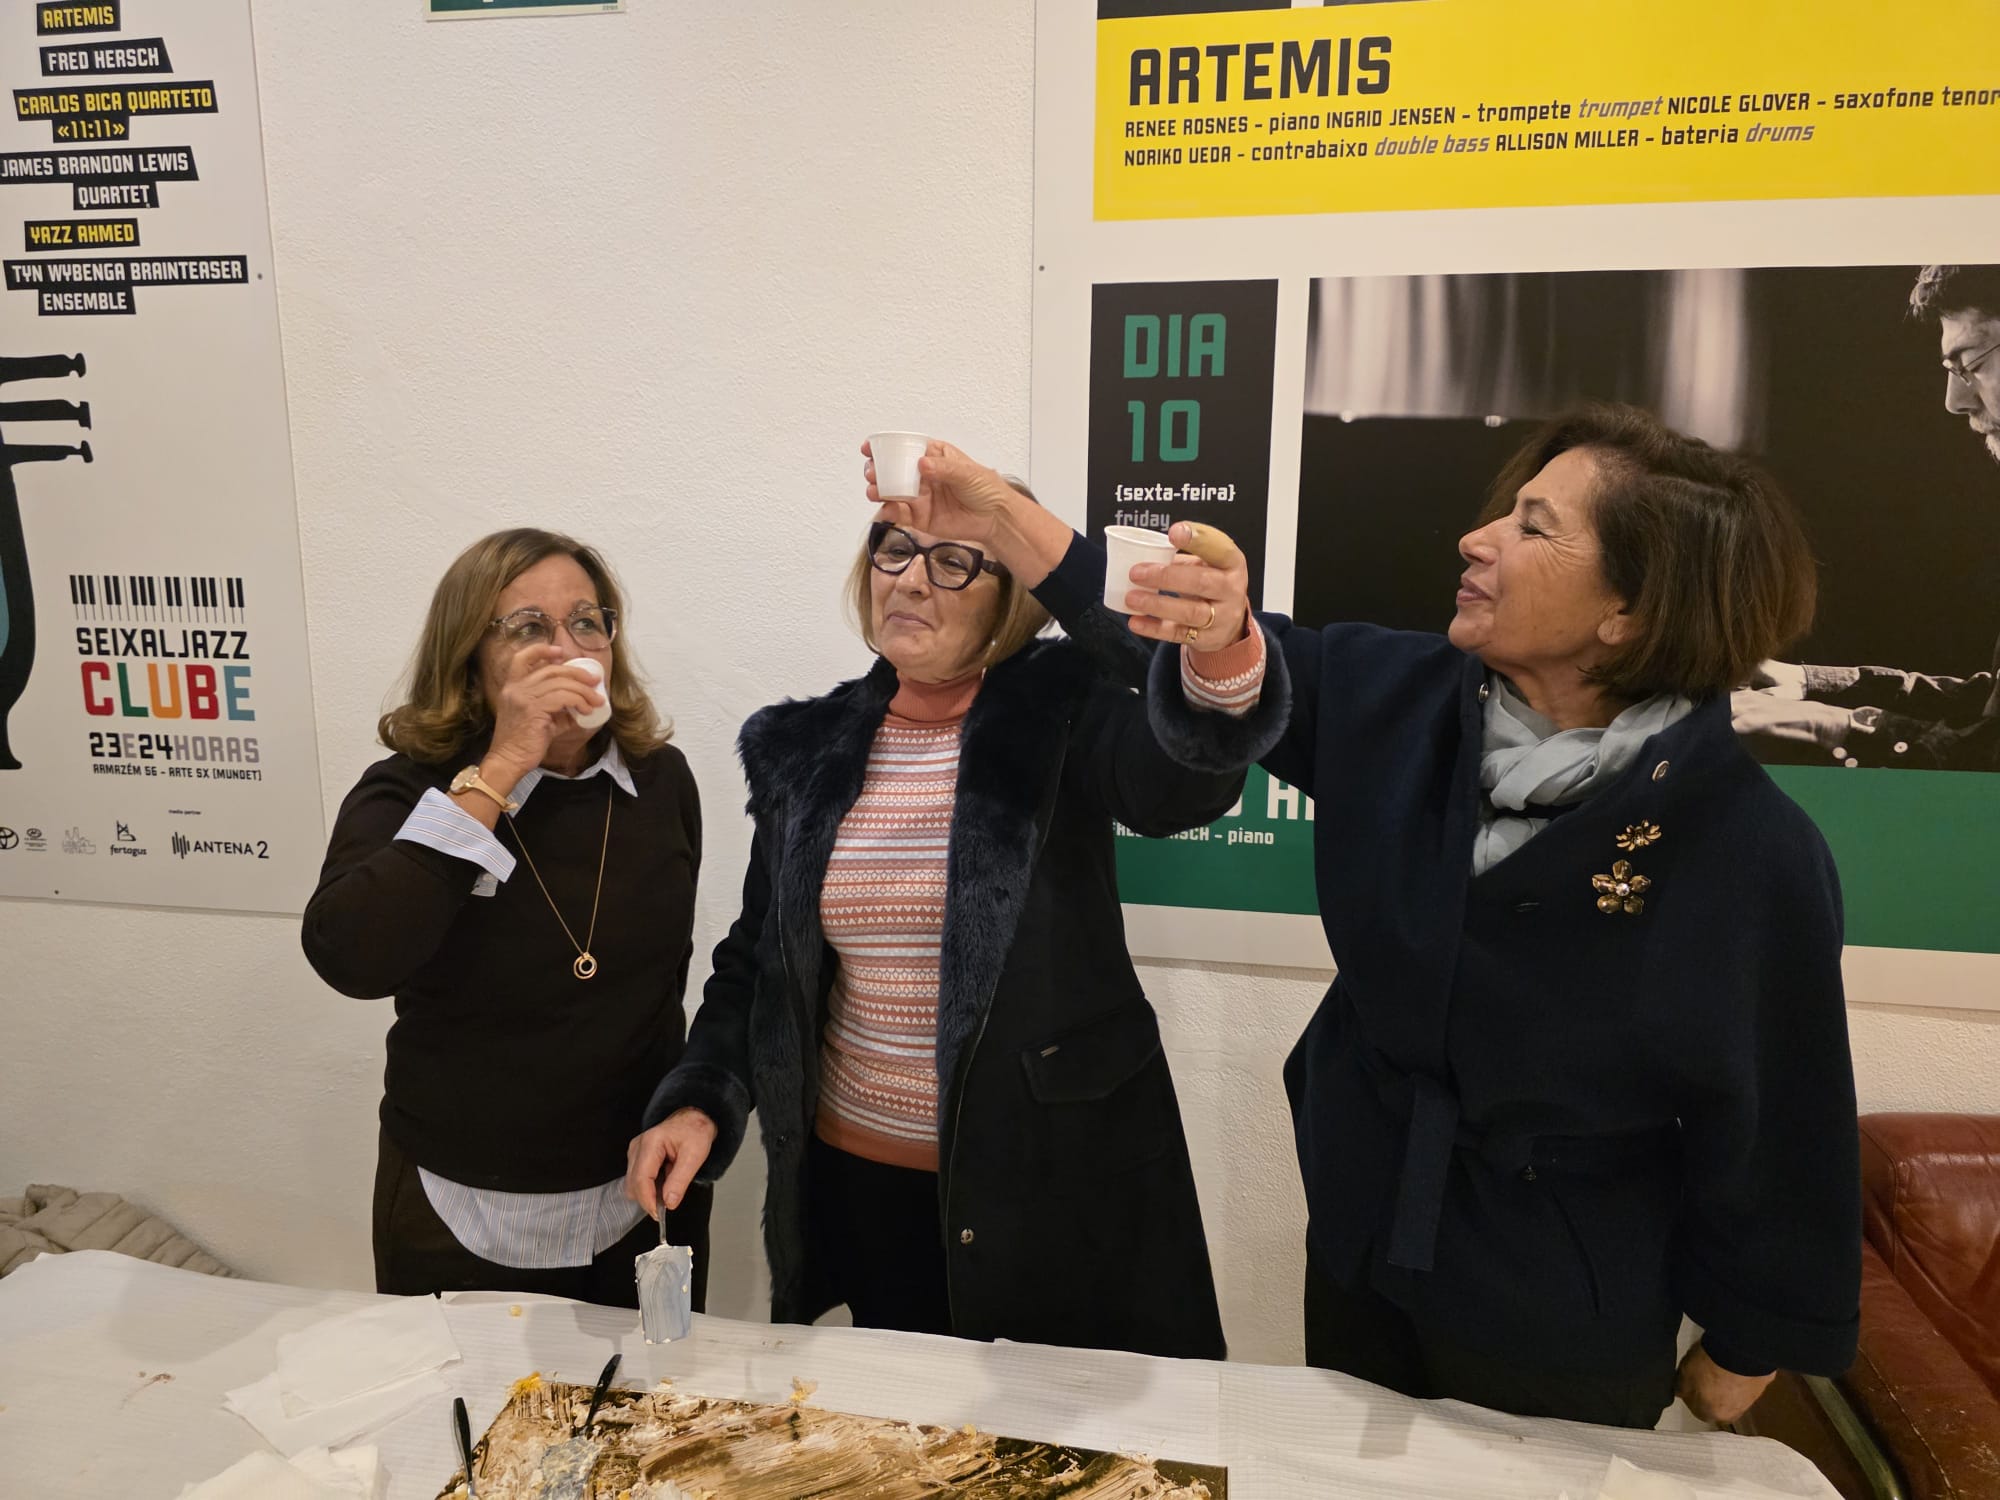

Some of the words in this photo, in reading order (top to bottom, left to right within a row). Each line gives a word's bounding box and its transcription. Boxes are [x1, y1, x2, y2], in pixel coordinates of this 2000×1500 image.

[43, 6, 114, 28] ARTEMIS
[48, 51, 89, 71] FRED
[95, 48, 160, 68] HERSCH
[1129, 36, 1392, 106] ARTEMIS
[19, 95, 80, 115] CARLOS
[86, 92, 122, 112] BICA
[128, 88, 212, 113] QUARTETO
[1125, 119, 1176, 138] RENEE
[1183, 116, 1248, 135] ROSNES
[1269, 111, 1320, 135] piano
[1326, 110, 1382, 129] INGRID
[1389, 107, 1456, 126] JENSEN
[1477, 99, 1571, 124] trompete
[1579, 96, 1664, 120] trumpet
[1668, 95, 1731, 115] NICOLE
[1739, 92, 1810, 113] GLOVER
[1834, 88, 1934, 109] saxofone
[1124, 148, 1182, 166] NORIKO
[1189, 146, 1231, 164] UEDA
[1251, 138, 1368, 162] contrabaixo
[1375, 135, 1439, 157] double
[1443, 136, 1490, 154] bass
[1496, 132, 1568, 152] ALLISON
[1574, 129, 1639, 148] MILLER
[1661, 124, 1739, 146] bateria
[1745, 123, 1815, 142] drums
[1, 157, 53, 177] JAMES
[59, 155, 133, 175] BRANDON
[139, 153, 189, 173] LEWIS
[78, 185, 150, 207] QUARTET
[30, 225, 73, 244] YAZZ
[78, 223, 134, 243] AHMED
[12, 265, 43, 283] TYN
[48, 262, 125, 282] WYBENGA
[131, 260, 242, 281] BRAINTEASER
[43, 292, 127, 311] ENSEMBLE
[1123, 313, 1226, 378] DIA
[1128, 399, 1200, 462] 10
[1115, 509, 1170, 530] friday
[76, 627, 250, 659] SEIXALJAZZ
[80, 661, 256, 721] CLUBE
[93, 763, 142, 776] ARMAZÉM
[145, 766, 157, 776] 56
[169, 767, 193, 778] ARTE
[196, 768, 210, 779] SX
[1228, 827, 1274, 845] piano
[193, 840, 254, 855] ANTENA
[257, 840, 269, 859] 2
